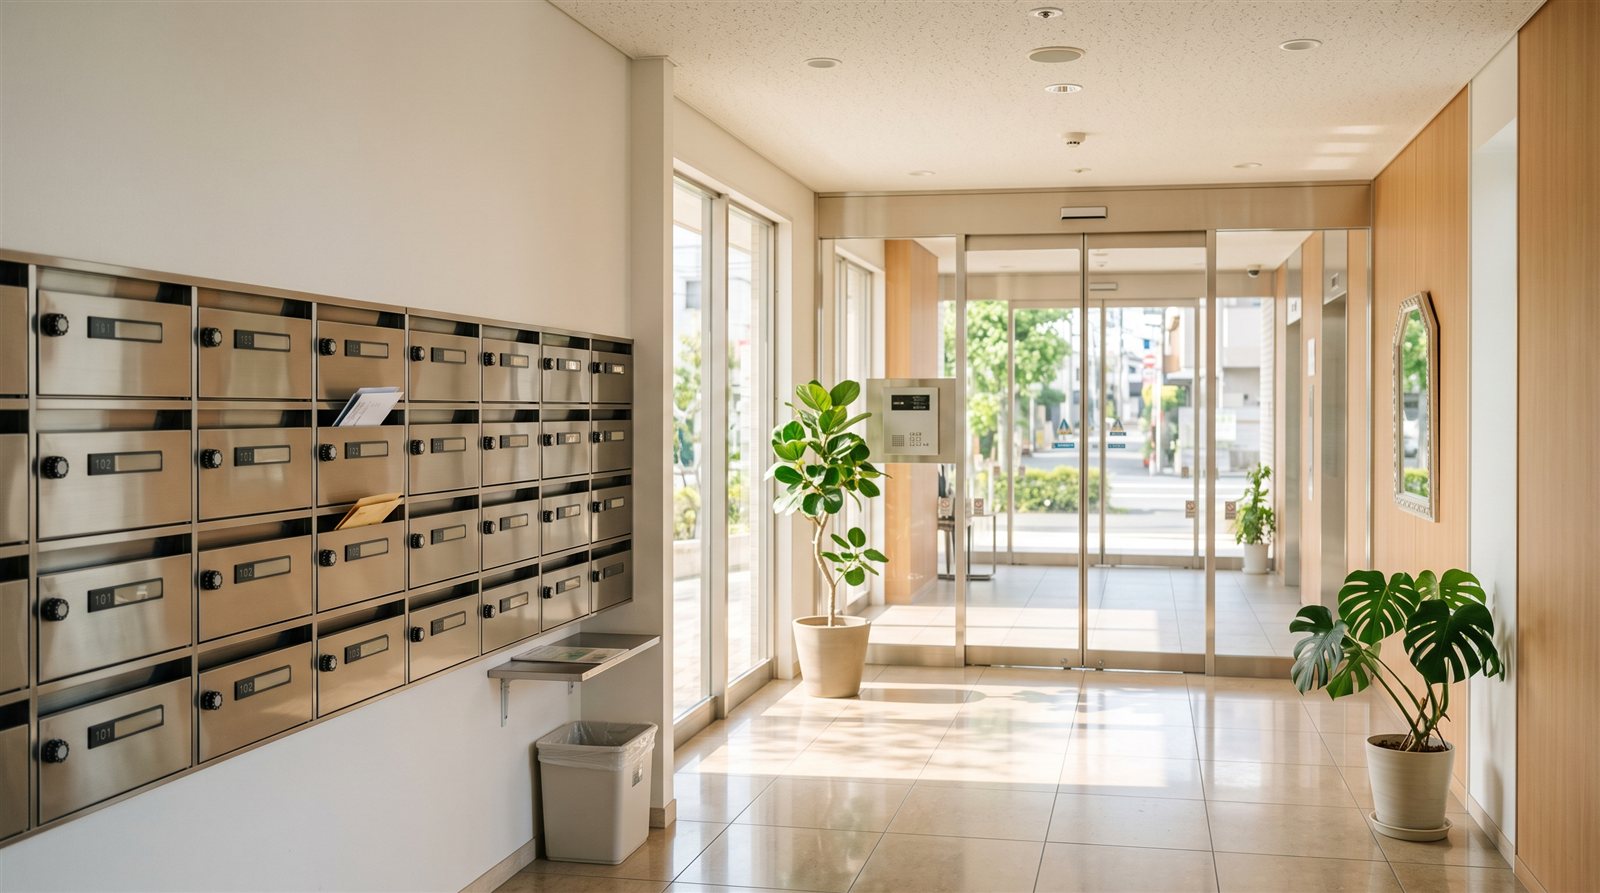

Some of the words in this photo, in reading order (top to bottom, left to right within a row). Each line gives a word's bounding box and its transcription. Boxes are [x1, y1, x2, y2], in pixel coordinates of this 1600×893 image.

[96, 458, 112, 470] 102
[239, 567, 253, 578] 102
[95, 592, 111, 606] 101
[239, 682, 253, 694] 102
[95, 727, 111, 742] 101
